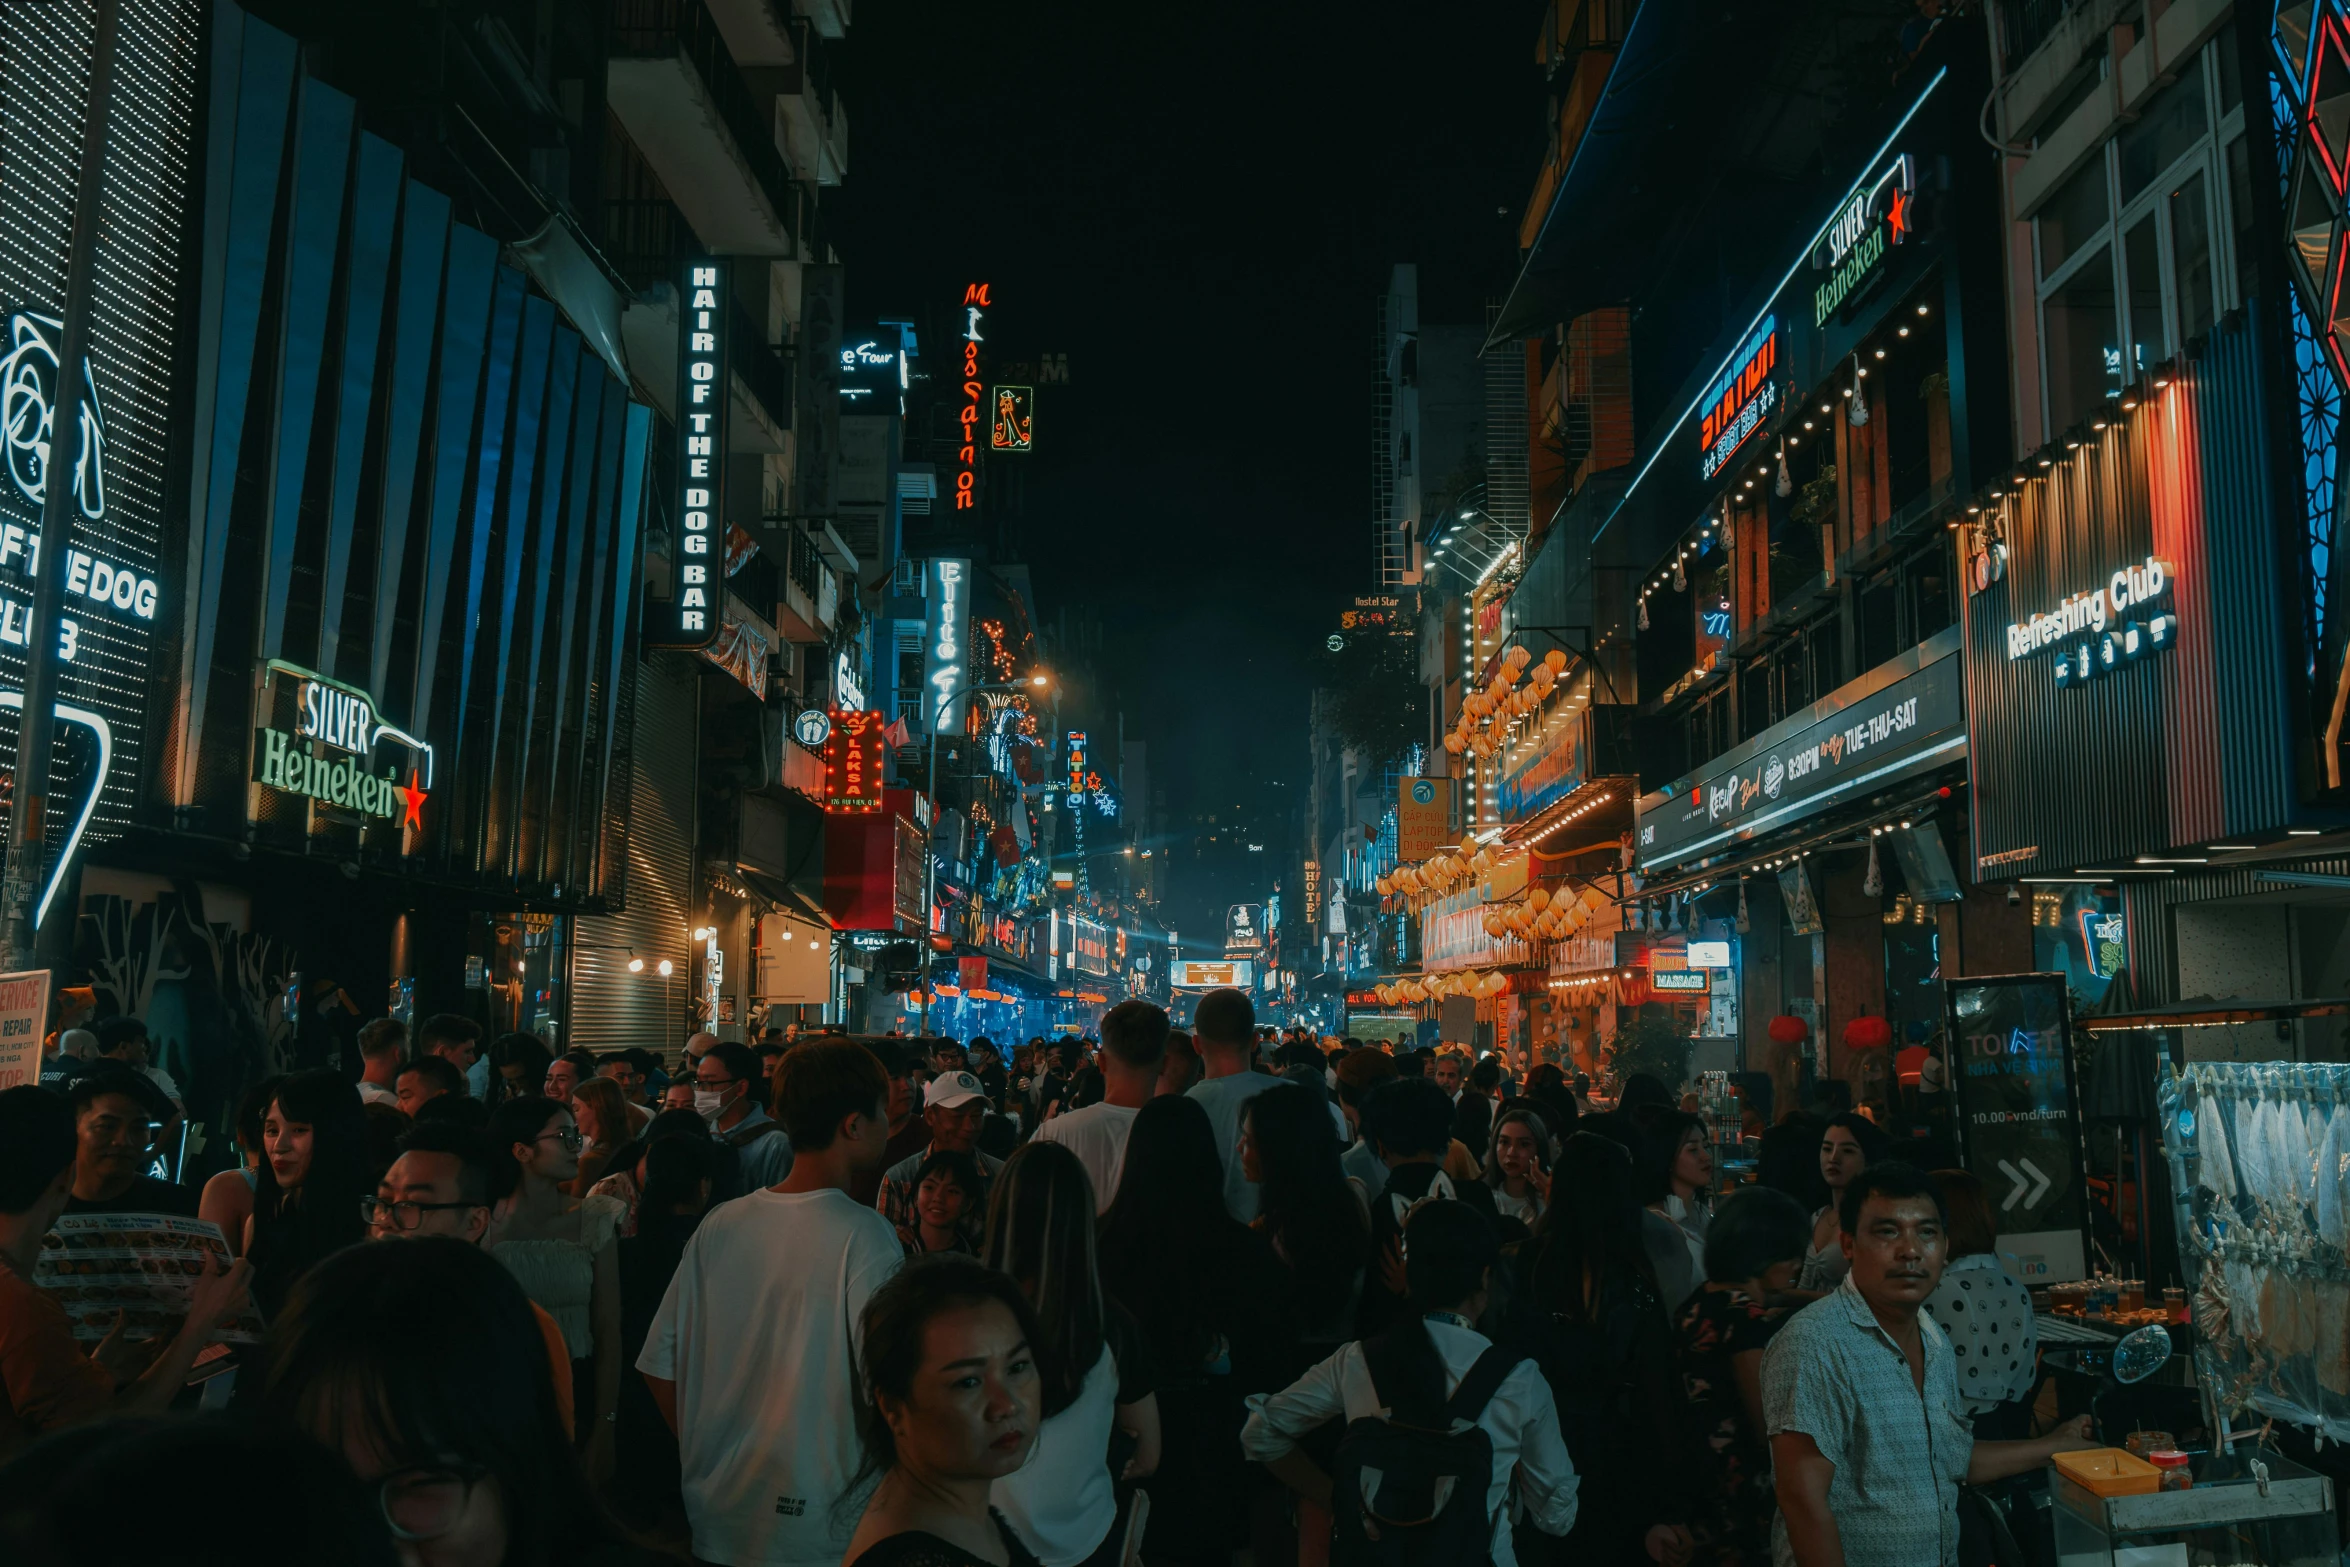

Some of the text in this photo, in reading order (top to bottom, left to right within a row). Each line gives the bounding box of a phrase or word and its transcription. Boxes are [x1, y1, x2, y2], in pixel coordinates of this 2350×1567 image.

[1830, 194, 1865, 267] SILVER
[1815, 225, 1884, 327] Heineken
[682, 267, 716, 630] HAIR OF THE DOG BAR
[956, 381, 983, 509] Saigon
[1717, 399, 1758, 465] SPORT BAR
[1381, 596, 1399, 606] Star
[2007, 556, 2165, 661] Refreshing Club
[305, 681, 369, 754] SILVER
[1788, 745, 1820, 780] 8:30PM
[1844, 697, 1917, 755] TUE-THU-SAT
[261, 728, 394, 818] Heineken
[846, 739, 861, 795] LAKSA
[1069, 740, 1083, 804] TATTOO
[1403, 825, 1444, 837] LAPTOP
[1403, 840, 1413, 851] DI
[1304, 861, 1316, 923] 99 HOTEL
[1348, 994, 1377, 1003] ALL YOU
[1656, 974, 1704, 988] MASSAGE
[2, 1018, 32, 1037] REPAIR
